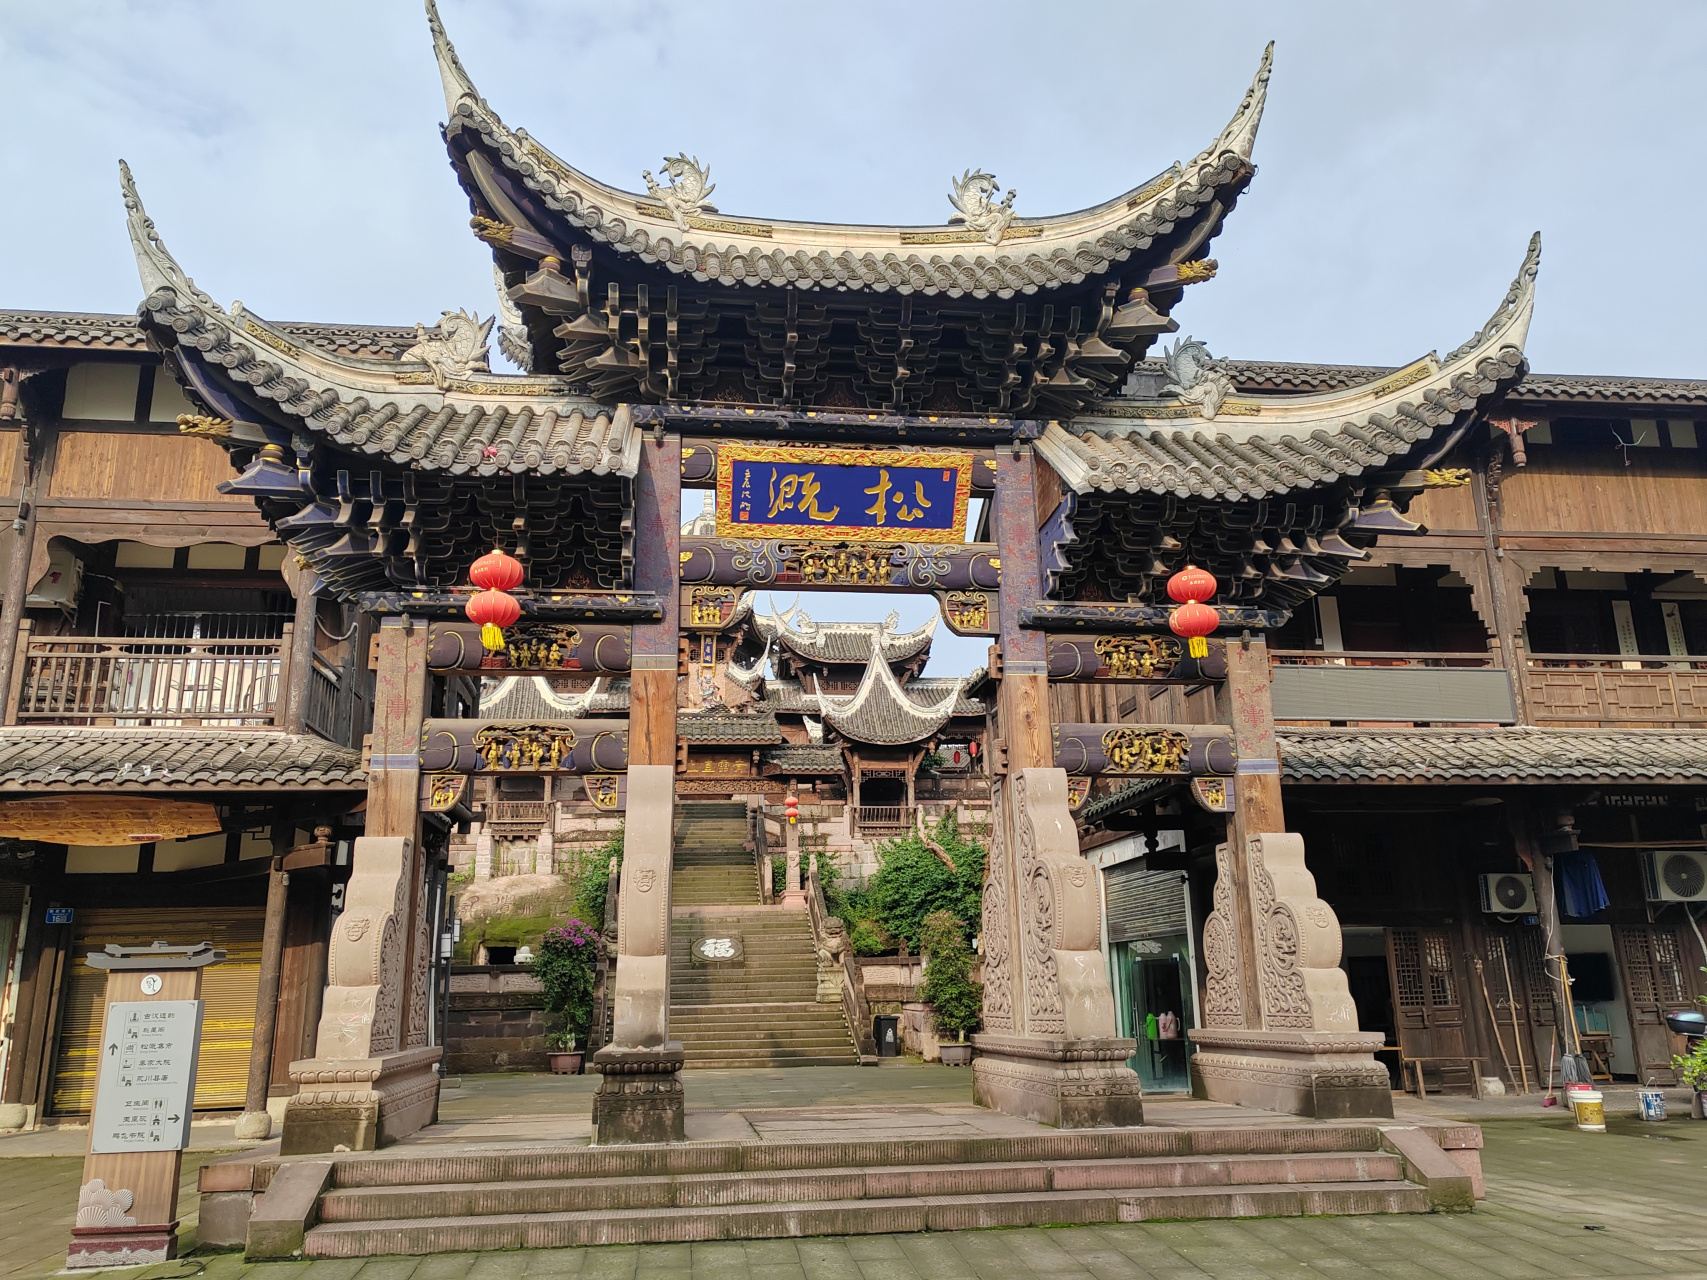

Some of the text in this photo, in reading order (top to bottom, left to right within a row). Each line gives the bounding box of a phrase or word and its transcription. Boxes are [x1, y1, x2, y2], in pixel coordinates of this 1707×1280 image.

[700, 938, 735, 958] 福
[124, 1099, 149, 1107] 卫生间
